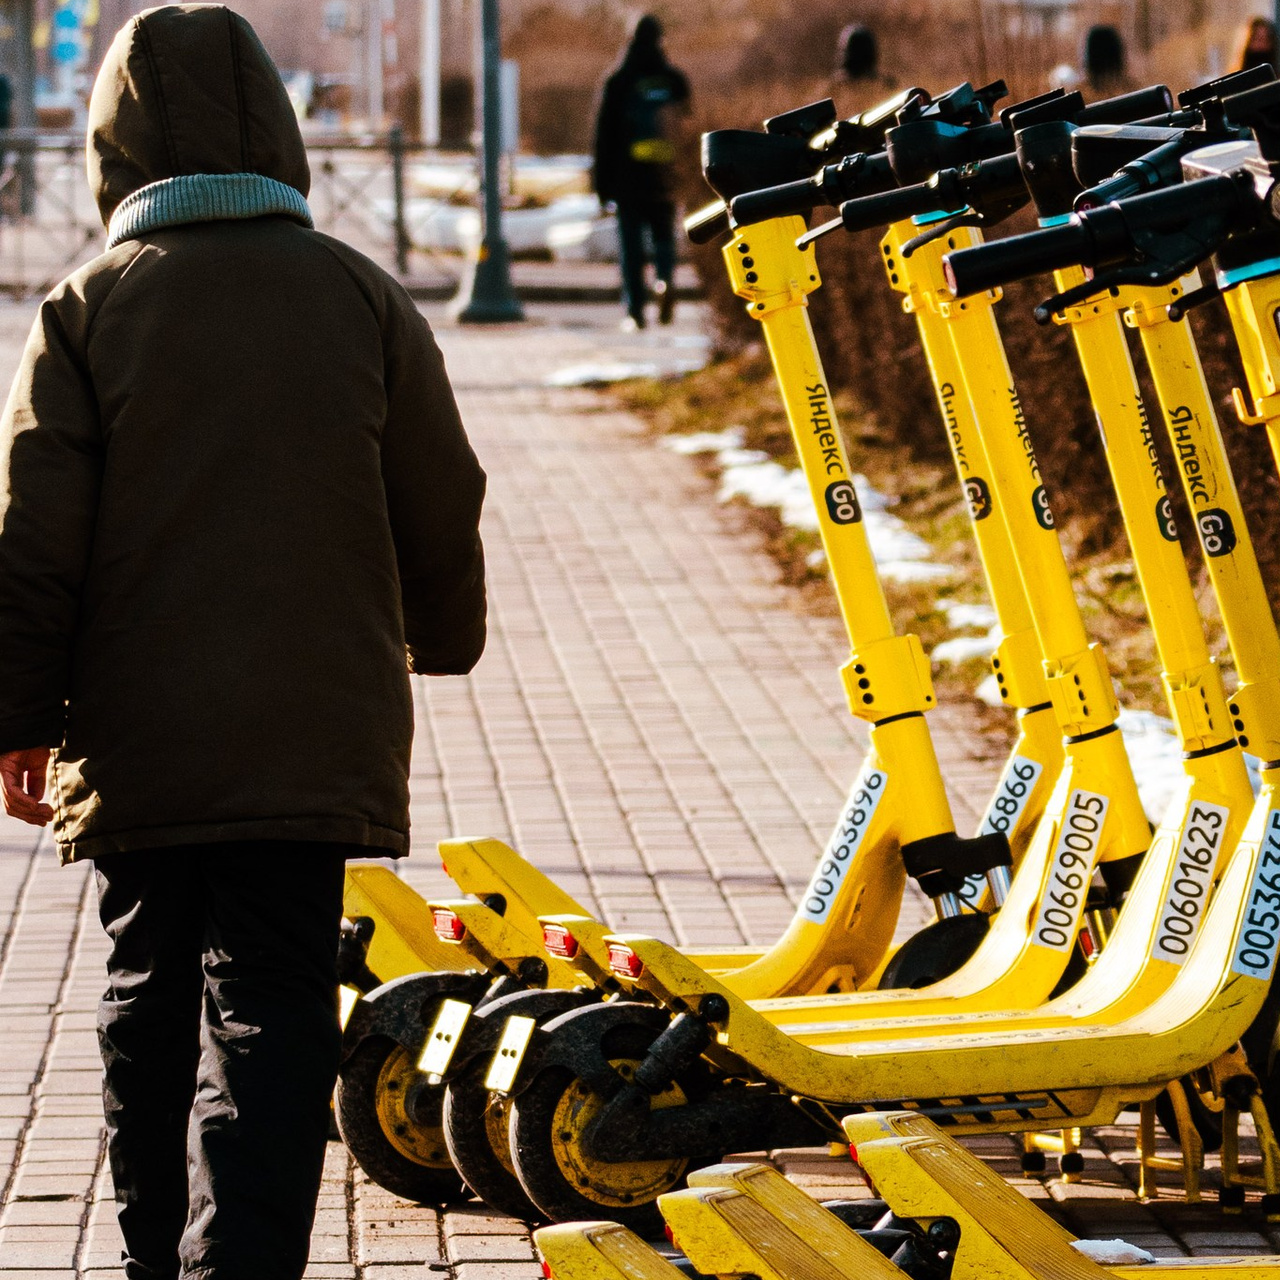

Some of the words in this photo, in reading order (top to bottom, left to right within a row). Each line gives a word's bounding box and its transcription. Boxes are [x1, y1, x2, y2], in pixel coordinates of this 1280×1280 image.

[806, 383, 844, 475] Яндекс
[830, 483, 857, 522] Go
[1168, 405, 1209, 504] Яндекс
[1198, 512, 1226, 555] Go
[805, 772, 883, 915] 00963896
[1038, 793, 1105, 947] 00669005
[1158, 806, 1223, 955] 00601623
